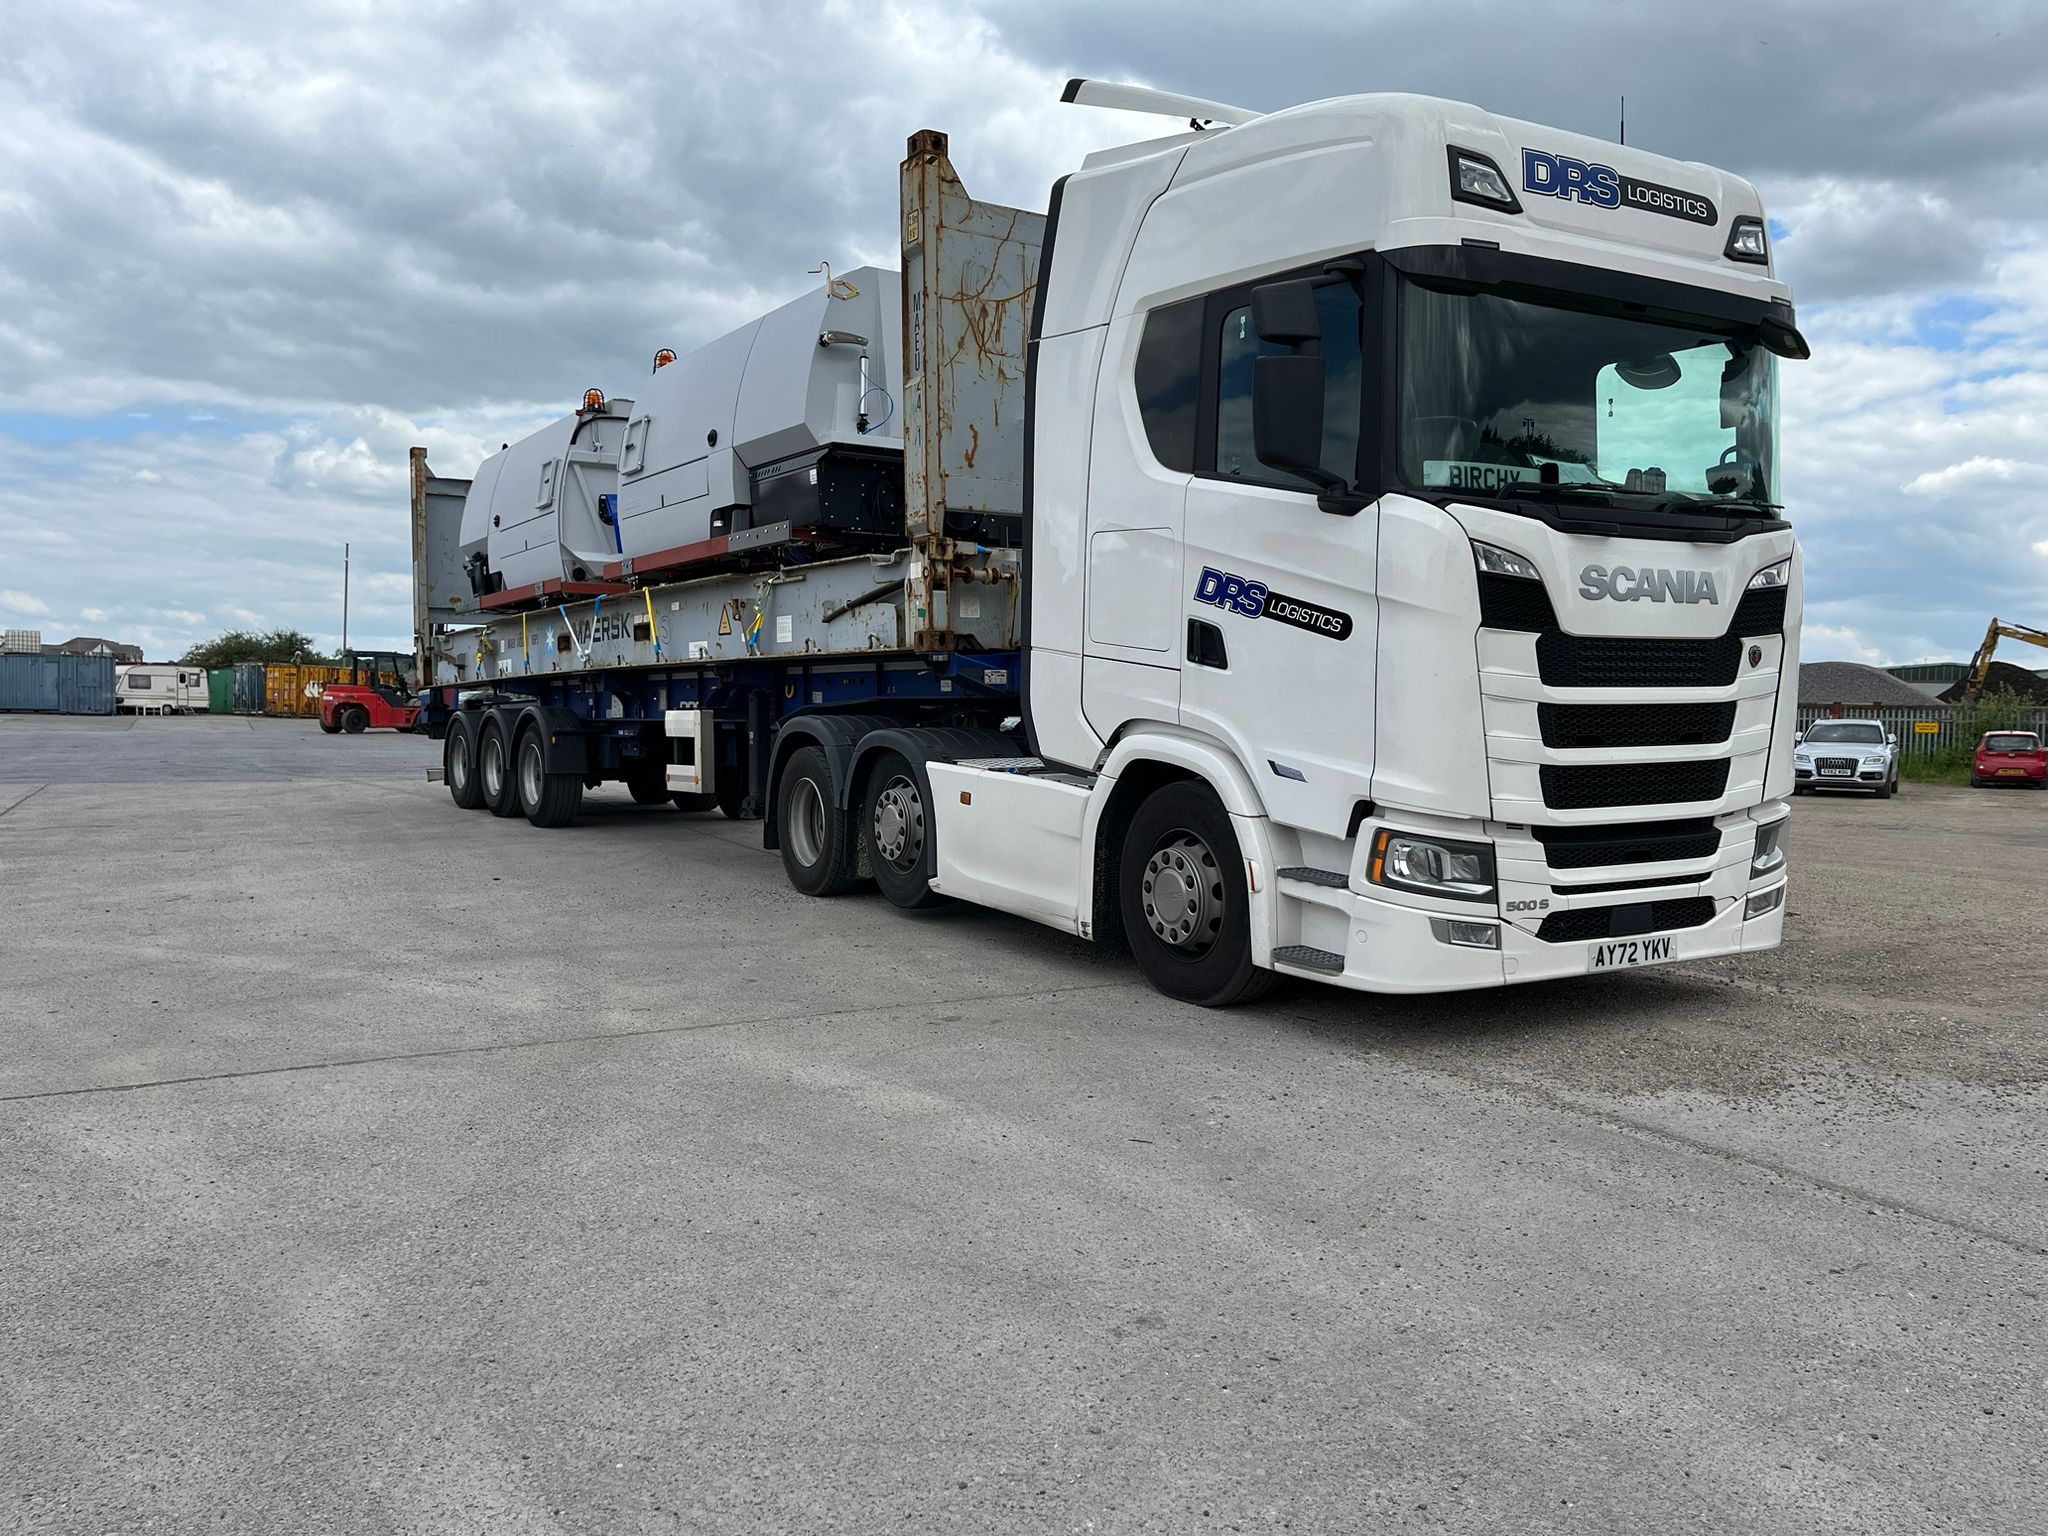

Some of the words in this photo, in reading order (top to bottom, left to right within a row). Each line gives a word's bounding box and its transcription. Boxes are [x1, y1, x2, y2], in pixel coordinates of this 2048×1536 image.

[1521, 147, 1621, 210] DRS
[1627, 184, 1708, 218] LOGISTICS
[1193, 566, 1269, 619] DRS
[1269, 599, 1343, 632] LOGISTICS
[1579, 564, 1719, 605] SCANIA
[1595, 941, 1638, 967] AY72
[1642, 937, 1670, 961] YKV
